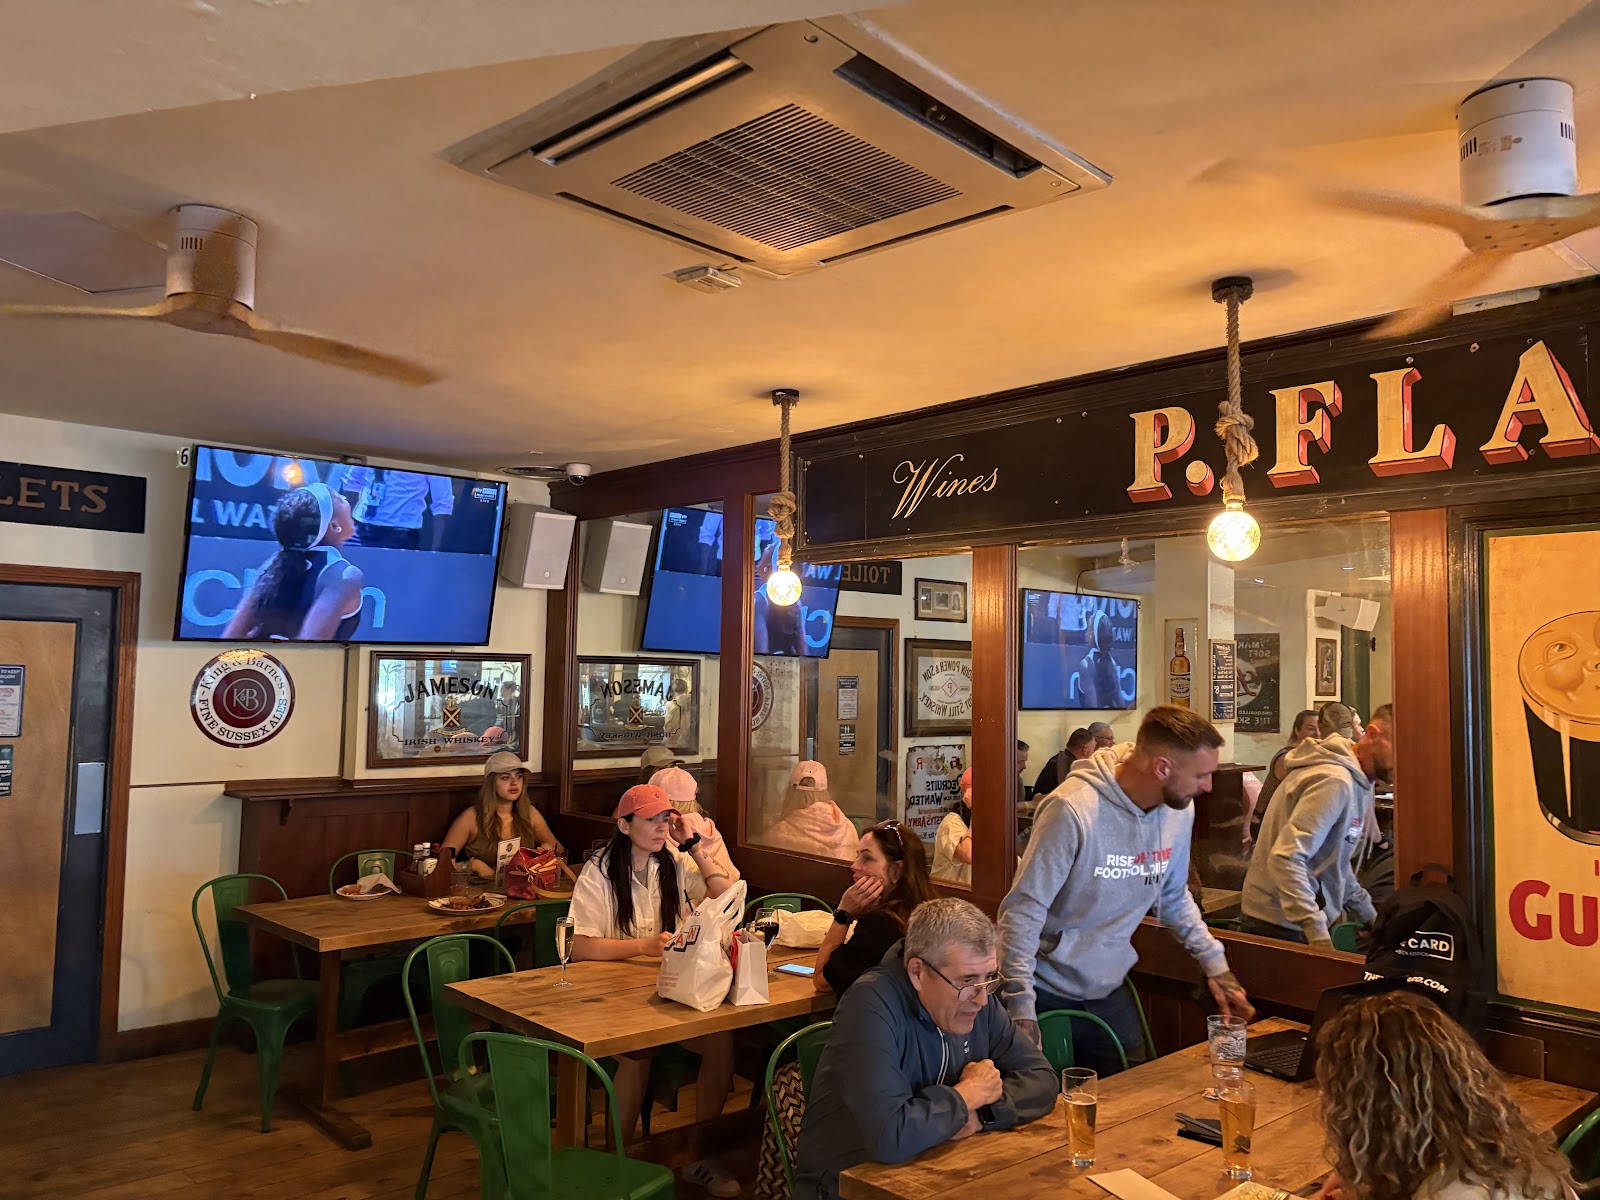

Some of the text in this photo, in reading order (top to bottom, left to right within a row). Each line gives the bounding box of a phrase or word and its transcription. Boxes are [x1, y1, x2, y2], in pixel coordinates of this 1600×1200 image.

[180, 448, 189, 466] 6
[892, 453, 999, 520] Wines
[200, 661, 232, 691] King
[246, 656, 286, 690] Barnes
[404, 676, 499, 703] JAMESON
[199, 697, 288, 742] FINE SUSSEX ALES
[404, 736, 496, 746] IRISH WHISKEY
[1106, 853, 1135, 867] RISE
[1407, 938, 1450, 952] CARD
